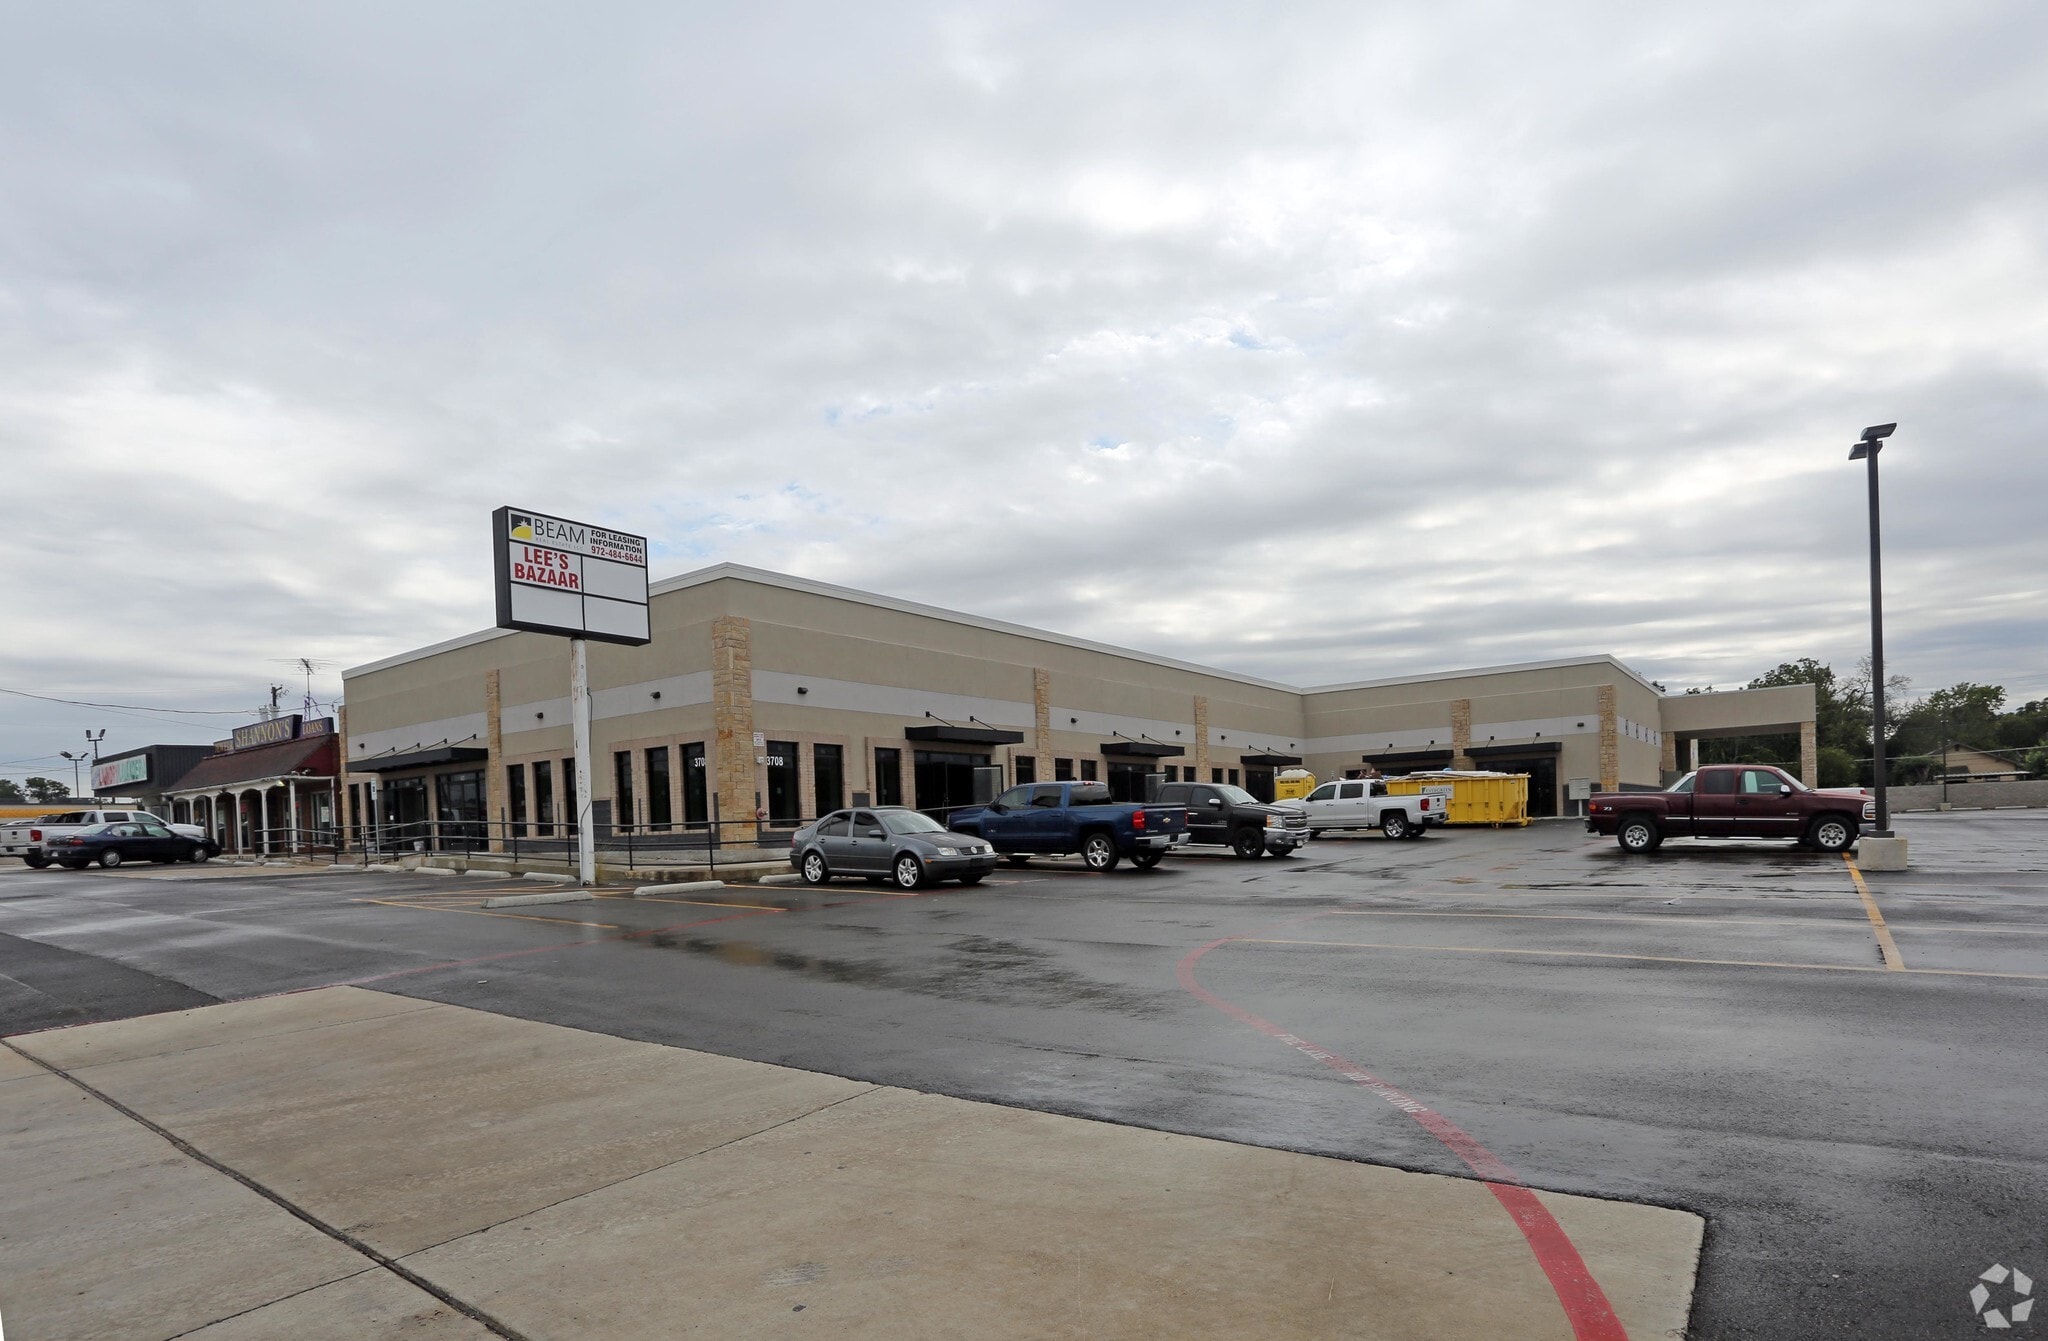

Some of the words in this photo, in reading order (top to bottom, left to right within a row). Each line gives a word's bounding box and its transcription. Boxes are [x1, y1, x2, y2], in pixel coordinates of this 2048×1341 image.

[534, 518, 585, 545] BEAM
[591, 530, 607, 539] FOR
[608, 534, 641, 547] LEASING
[590, 537, 642, 554] INFORMATION
[591, 545, 643, 564] 972-484-6644
[524, 546, 569, 570] LEE'S
[514, 562, 579, 589] BAZAAR
[236, 718, 290, 748] SHANNON'S
[302, 721, 323, 735] LOANS
[694, 757, 706, 768] 370
[766, 756, 784, 766] 3708
